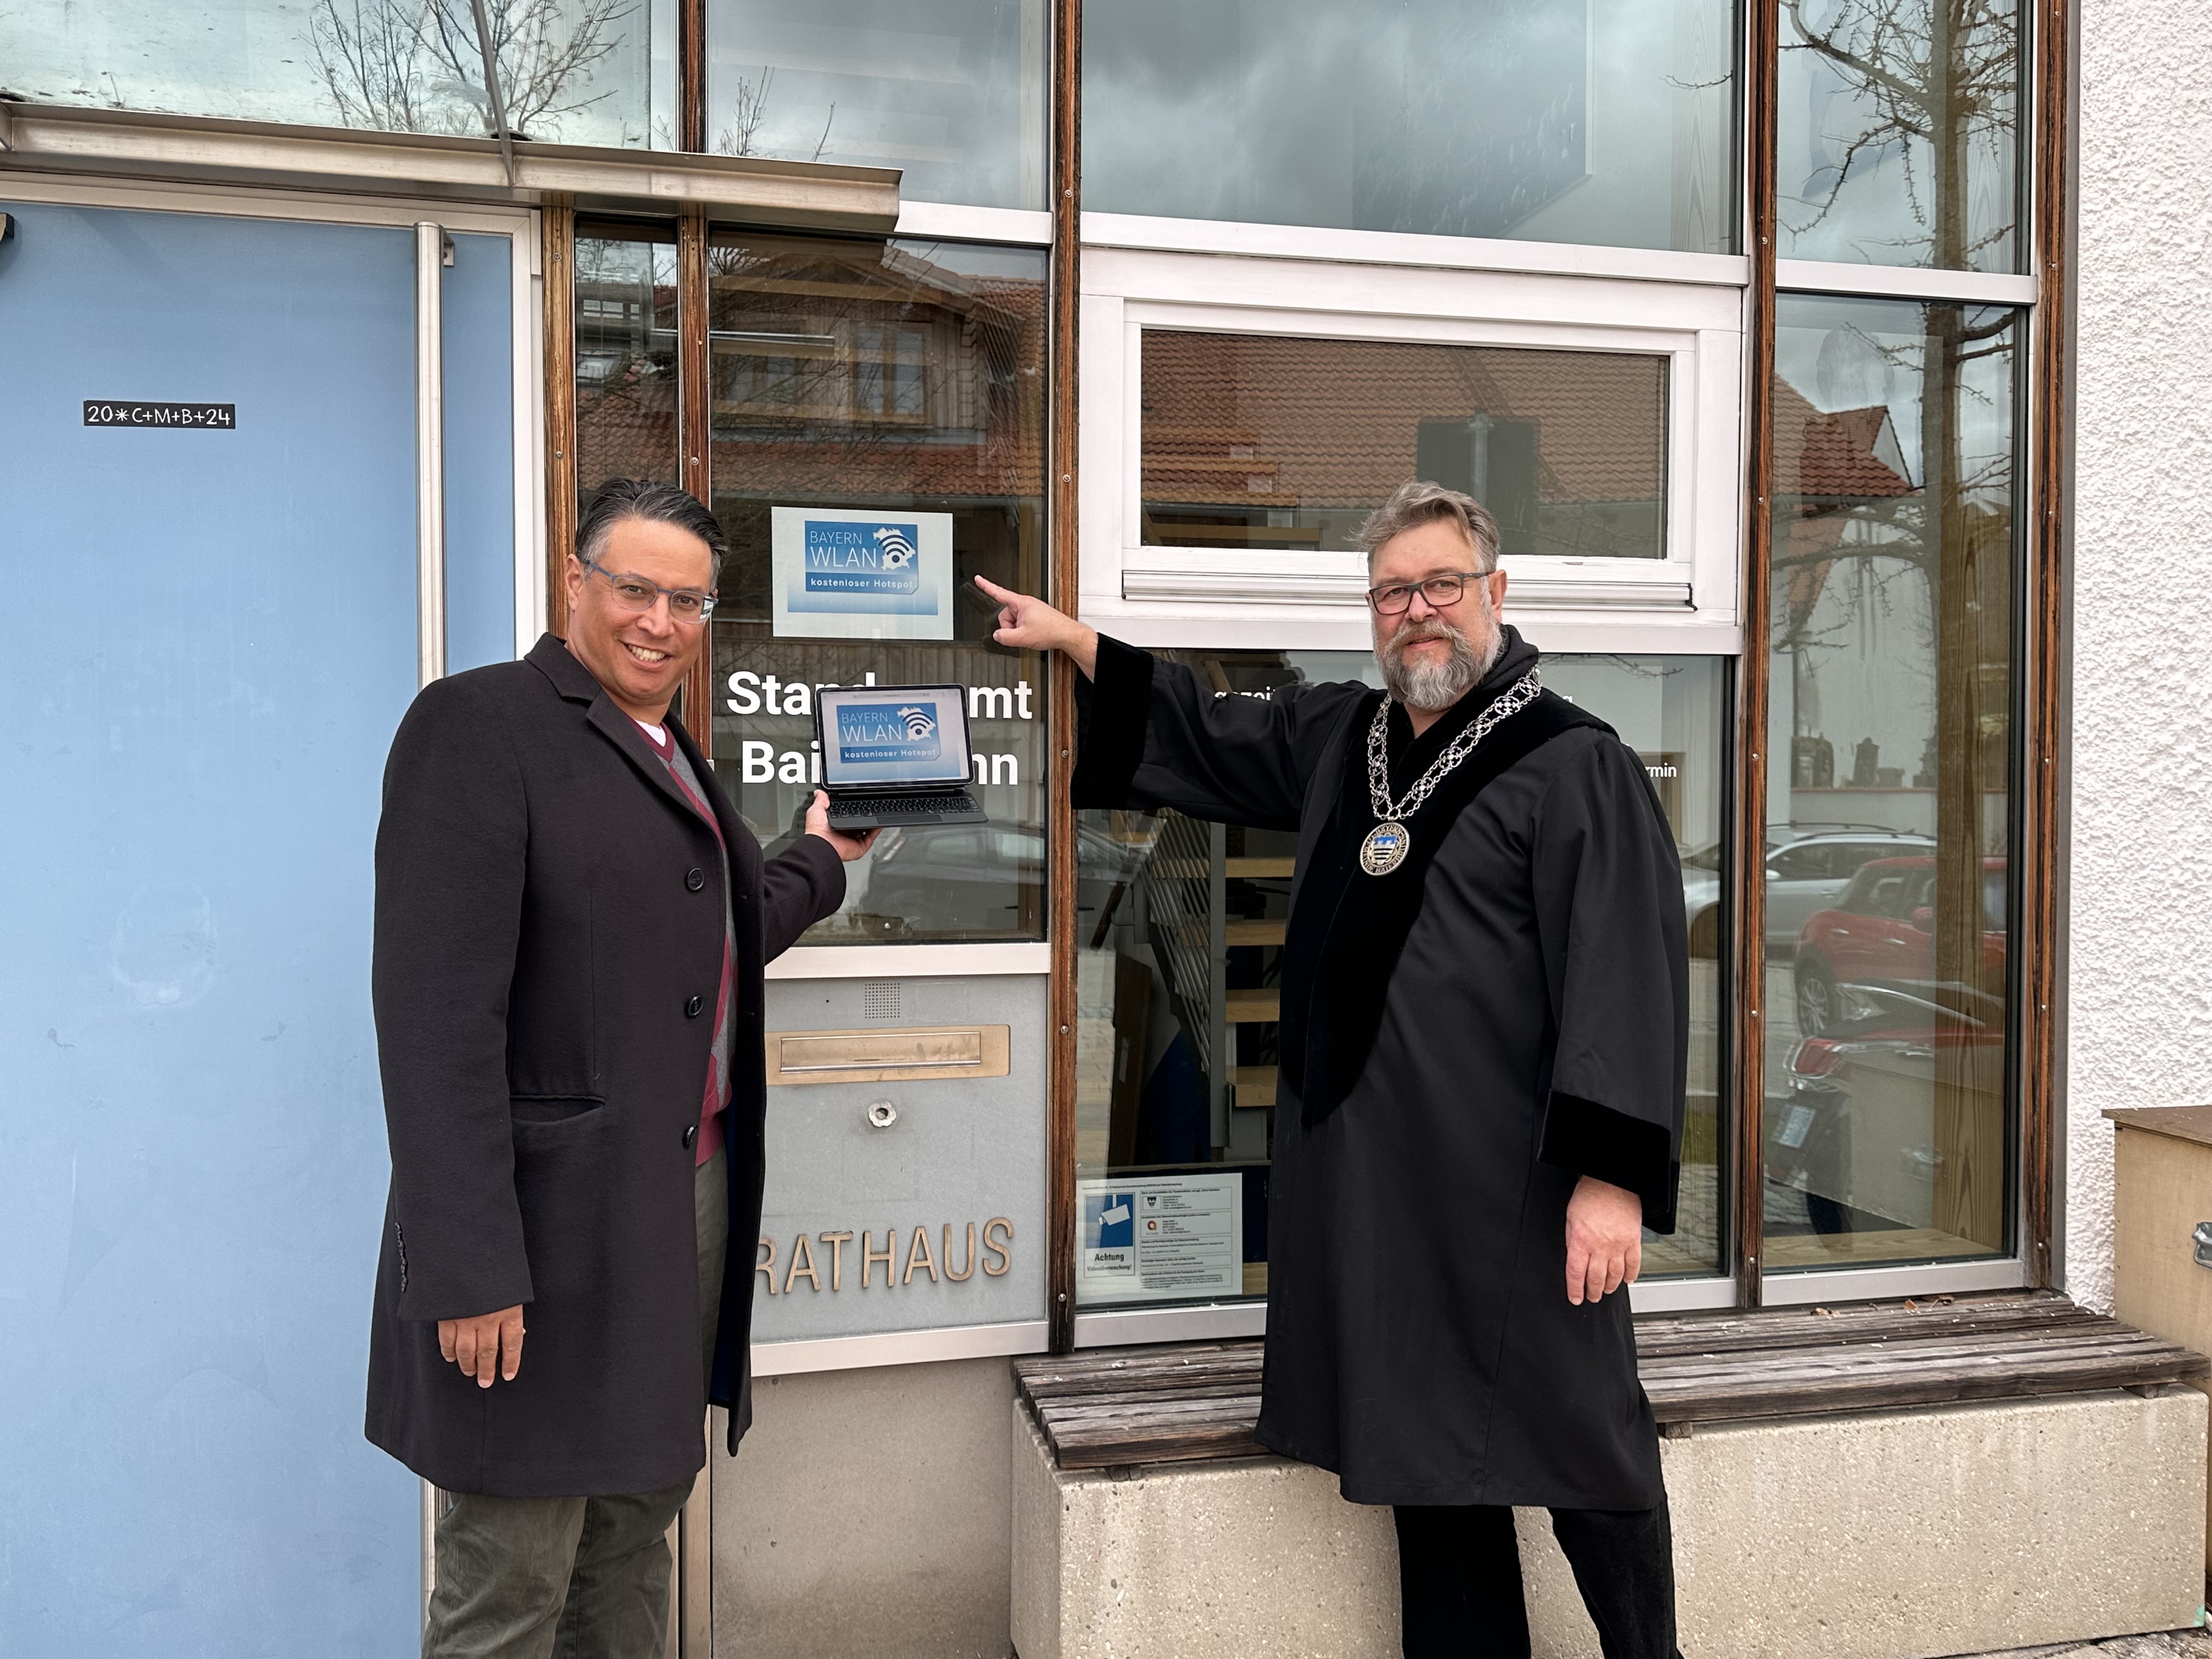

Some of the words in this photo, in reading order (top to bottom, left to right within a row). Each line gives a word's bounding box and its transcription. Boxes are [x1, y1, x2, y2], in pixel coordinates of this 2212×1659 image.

[810, 531, 862, 545] BAYERN
[810, 546, 877, 568] WLAN
[811, 578, 870, 587] kostenloser
[874, 579, 913, 589] Hotspot
[842, 712, 888, 723] BAYERN
[843, 724, 902, 742] WLAN
[901, 749, 936, 757] Hotspot
[755, 1217, 1014, 1295] RATHAUS
[1094, 1253, 1124, 1262] Achtung
